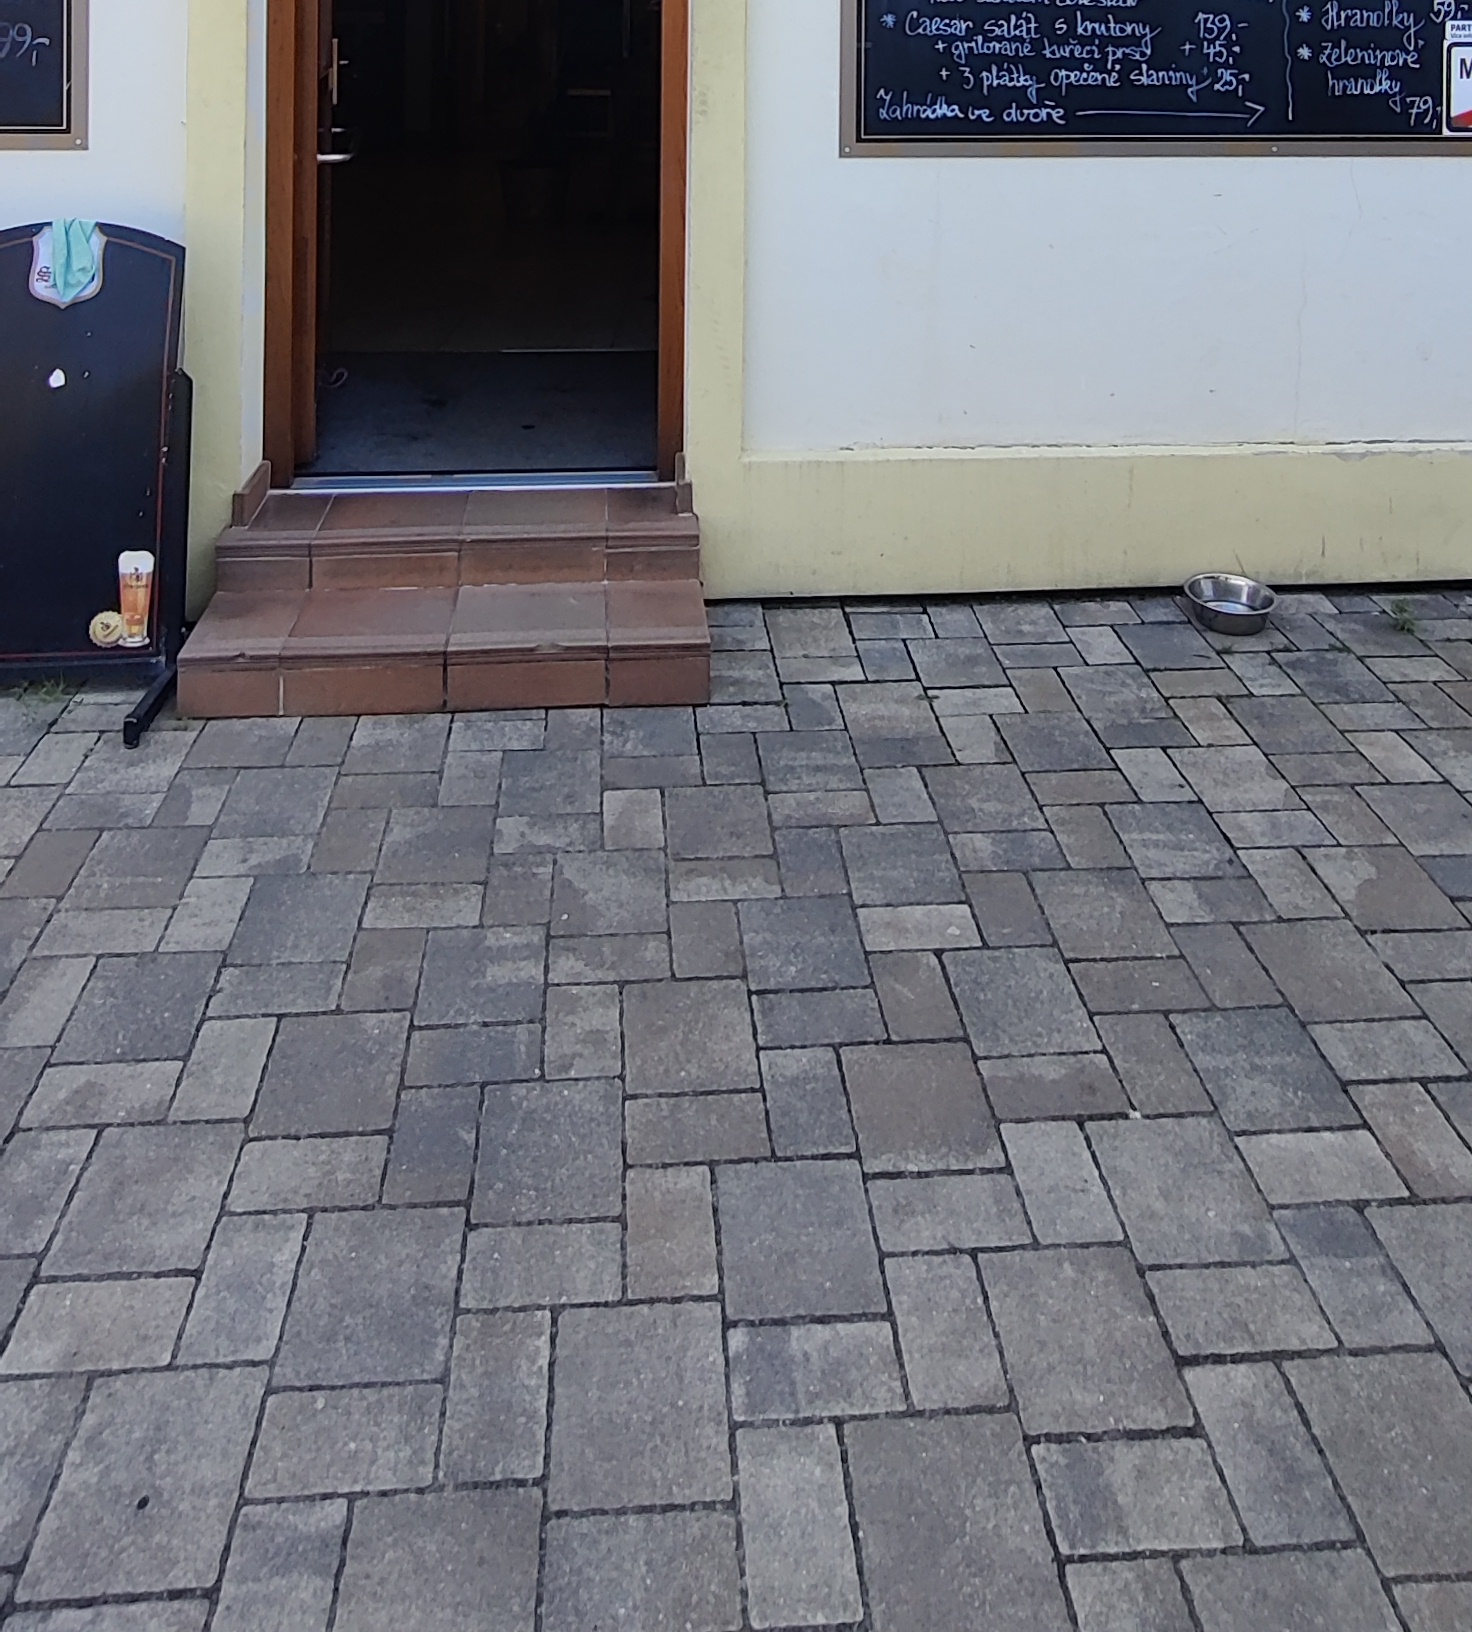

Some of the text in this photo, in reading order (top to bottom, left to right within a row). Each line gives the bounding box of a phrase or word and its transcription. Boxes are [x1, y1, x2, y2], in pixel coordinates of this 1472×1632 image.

[905, 10, 974, 36] Caesar
[983, 11, 1041, 39] salát
[1054, 18, 1067, 35] s
[1076, 10, 1162, 44] krutony
[1320, 0, 1425, 51] Hranolky
[951, 35, 1036, 64] grilované
[1042, 38, 1102, 59] kuřecí
[1319, 38, 1425, 69] Zeleninové
[958, 67, 974, 89] 3
[979, 62, 1046, 104] plátky
[1050, 63, 1121, 96] opečené
[1129, 63, 1213, 103] slaniny
[1327, 68, 1406, 113] hranolky
[876, 88, 1066, 125] Zahrádka ve dvoře
